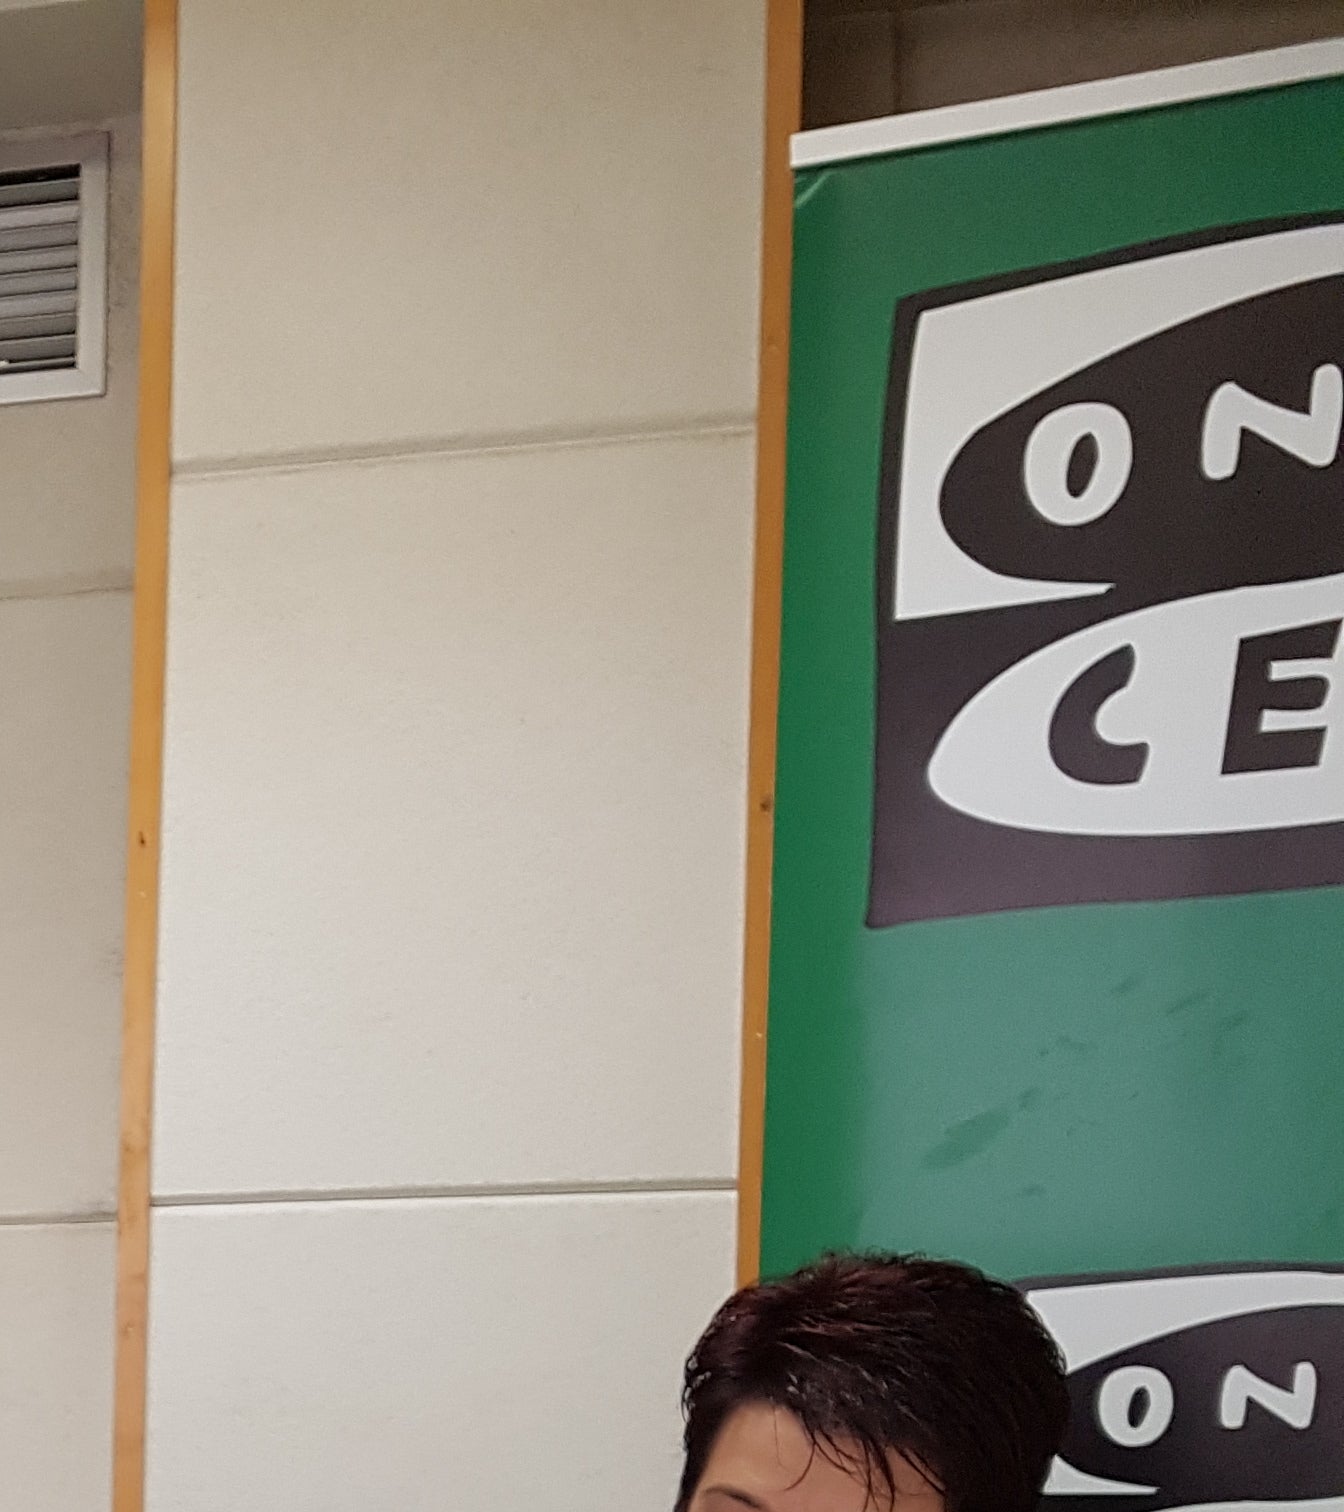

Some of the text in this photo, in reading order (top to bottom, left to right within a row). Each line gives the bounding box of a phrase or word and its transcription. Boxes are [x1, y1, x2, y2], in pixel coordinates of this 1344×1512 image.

[1023, 363, 1344, 527] ON
[1048, 621, 1344, 785] CE
[1099, 1361, 1317, 1448] ON
